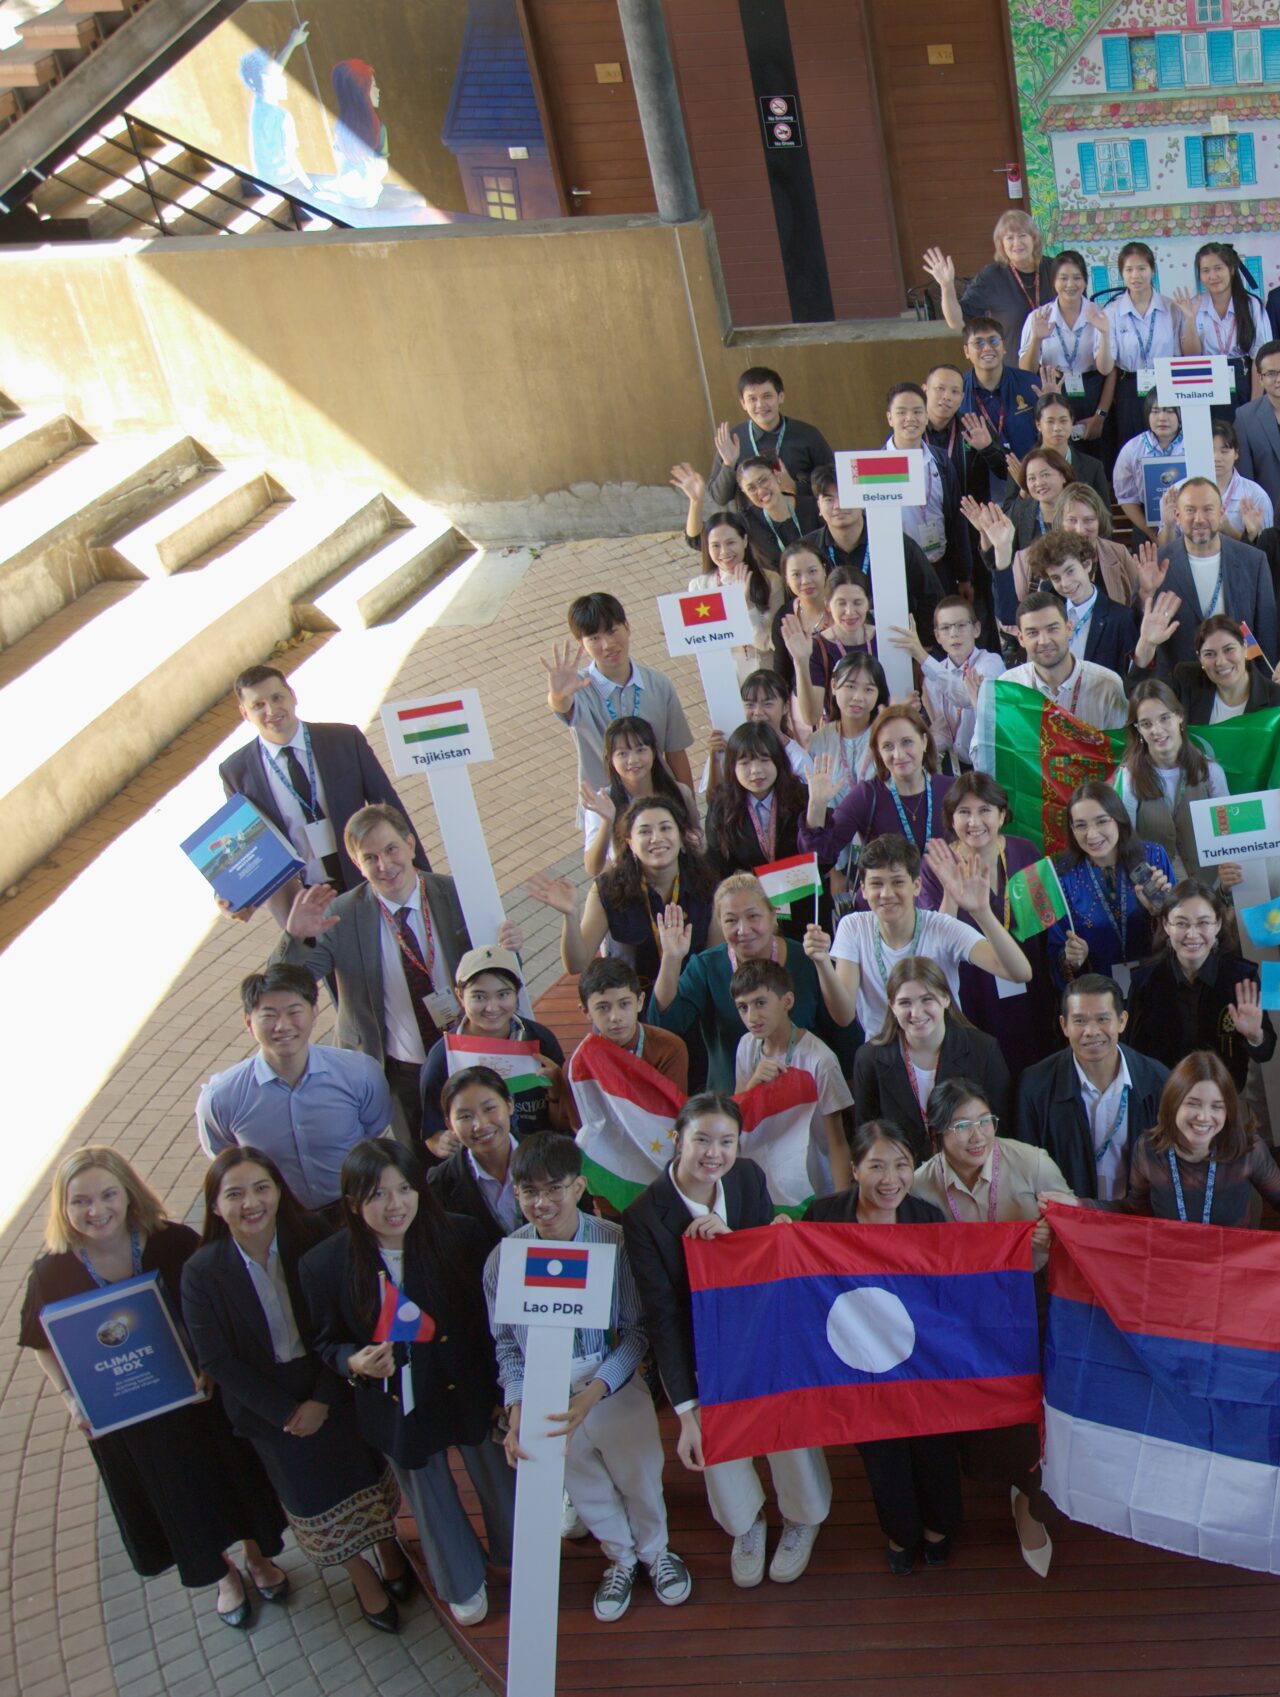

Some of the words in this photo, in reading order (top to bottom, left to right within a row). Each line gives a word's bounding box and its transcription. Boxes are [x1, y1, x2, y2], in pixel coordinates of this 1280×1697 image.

[1174, 390, 1214, 399] Thailand
[862, 492, 904, 502] Belarus
[684, 635, 707, 646] Viet
[708, 631, 735, 642] Nam
[411, 747, 472, 765] Tajikistan
[523, 1301, 549, 1313] Lao
[552, 1302, 584, 1316] PDR
[94, 1345, 155, 1372] CLIMATE
[112, 1358, 144, 1376] BOX
